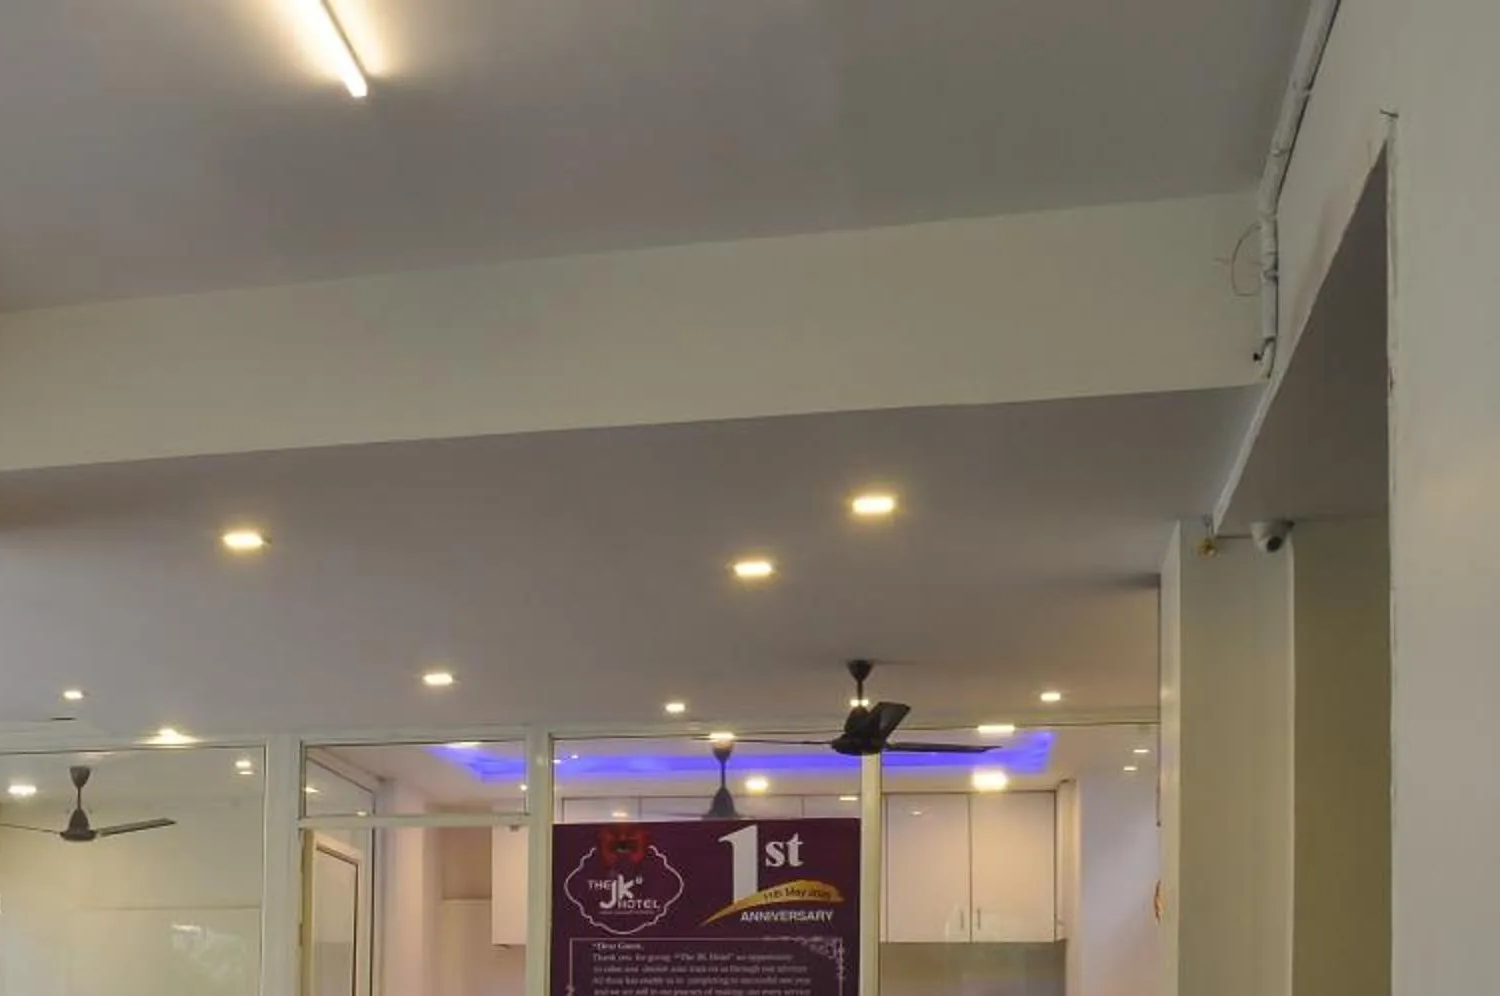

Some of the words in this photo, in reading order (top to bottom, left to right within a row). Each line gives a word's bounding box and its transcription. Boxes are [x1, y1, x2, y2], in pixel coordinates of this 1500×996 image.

[718, 824, 804, 904] 1st
[588, 879, 611, 890] THE
[618, 899, 661, 909] HOTEL
[741, 909, 834, 922] ANNIVERSARY
